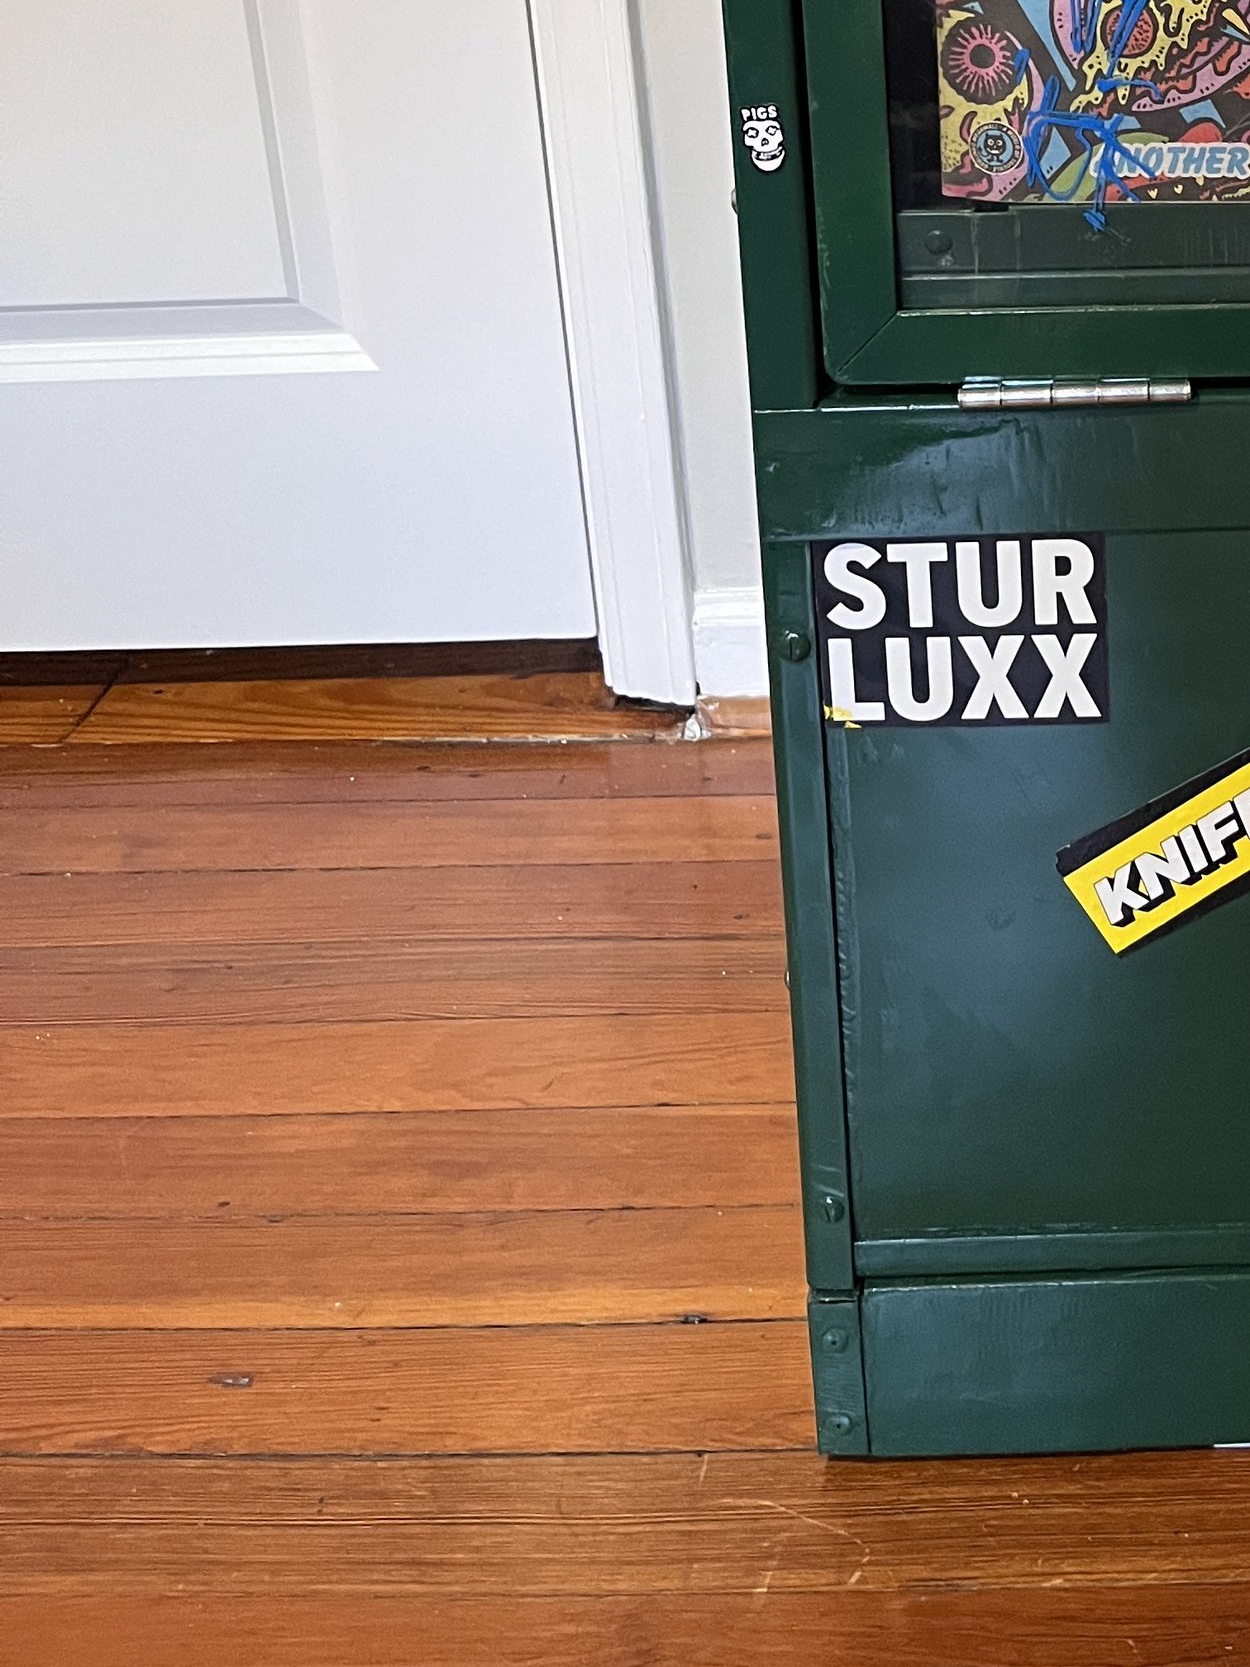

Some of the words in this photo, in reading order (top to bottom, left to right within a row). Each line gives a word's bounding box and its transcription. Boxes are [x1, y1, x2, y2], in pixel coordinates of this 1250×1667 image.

[741, 105, 778, 121] PIGS
[824, 539, 1097, 630] STUR
[827, 633, 1102, 721] LUXX
